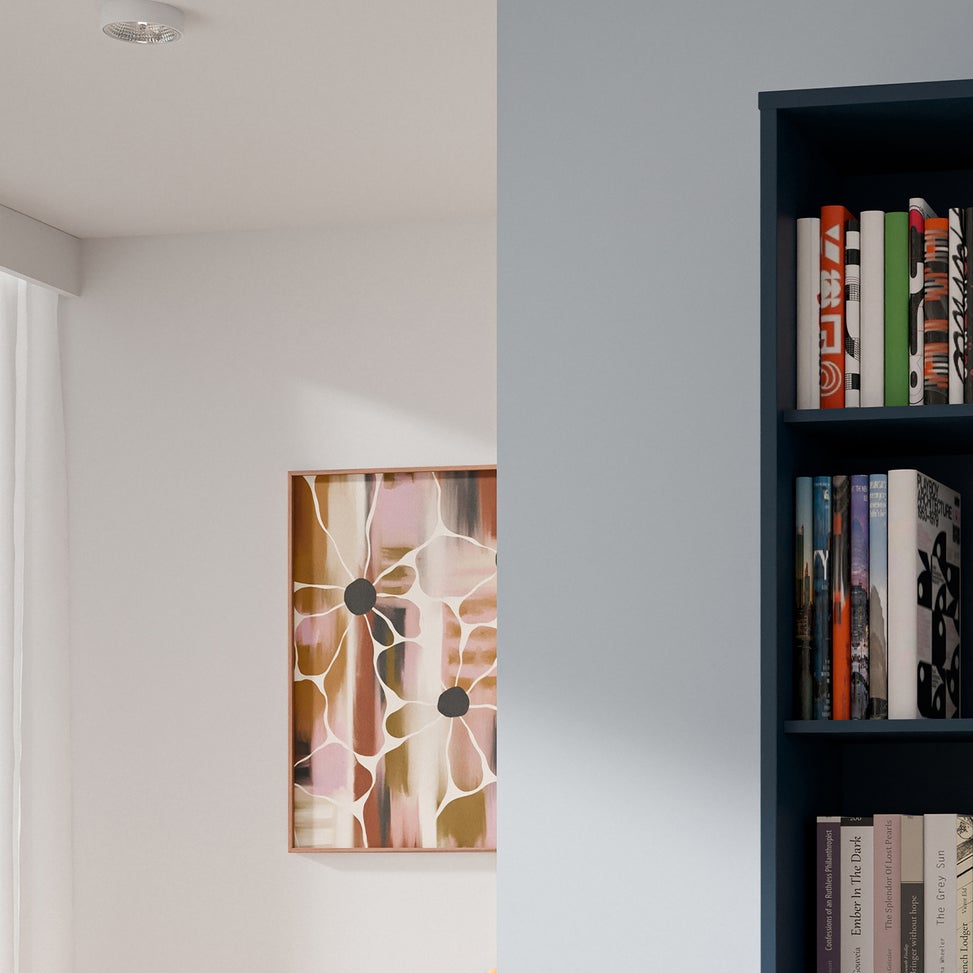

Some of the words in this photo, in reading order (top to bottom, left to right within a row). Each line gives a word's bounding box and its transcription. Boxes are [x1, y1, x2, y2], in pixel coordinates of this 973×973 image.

[825, 830, 834, 872] Philanthropist
[850, 836, 861, 863] Dark
[936, 850, 945, 869] Sun
[850, 866, 861, 885] The
[885, 866, 892, 875] Of
[850, 888, 861, 898] In
[885, 877, 893, 913] Splendor
[936, 874, 946, 901] Grey
[850, 902, 861, 936] Ember
[909, 896, 918, 915] hope
[936, 906, 945, 925] The
[909, 916, 917, 947] without
[960, 923, 969, 952] Lodger
